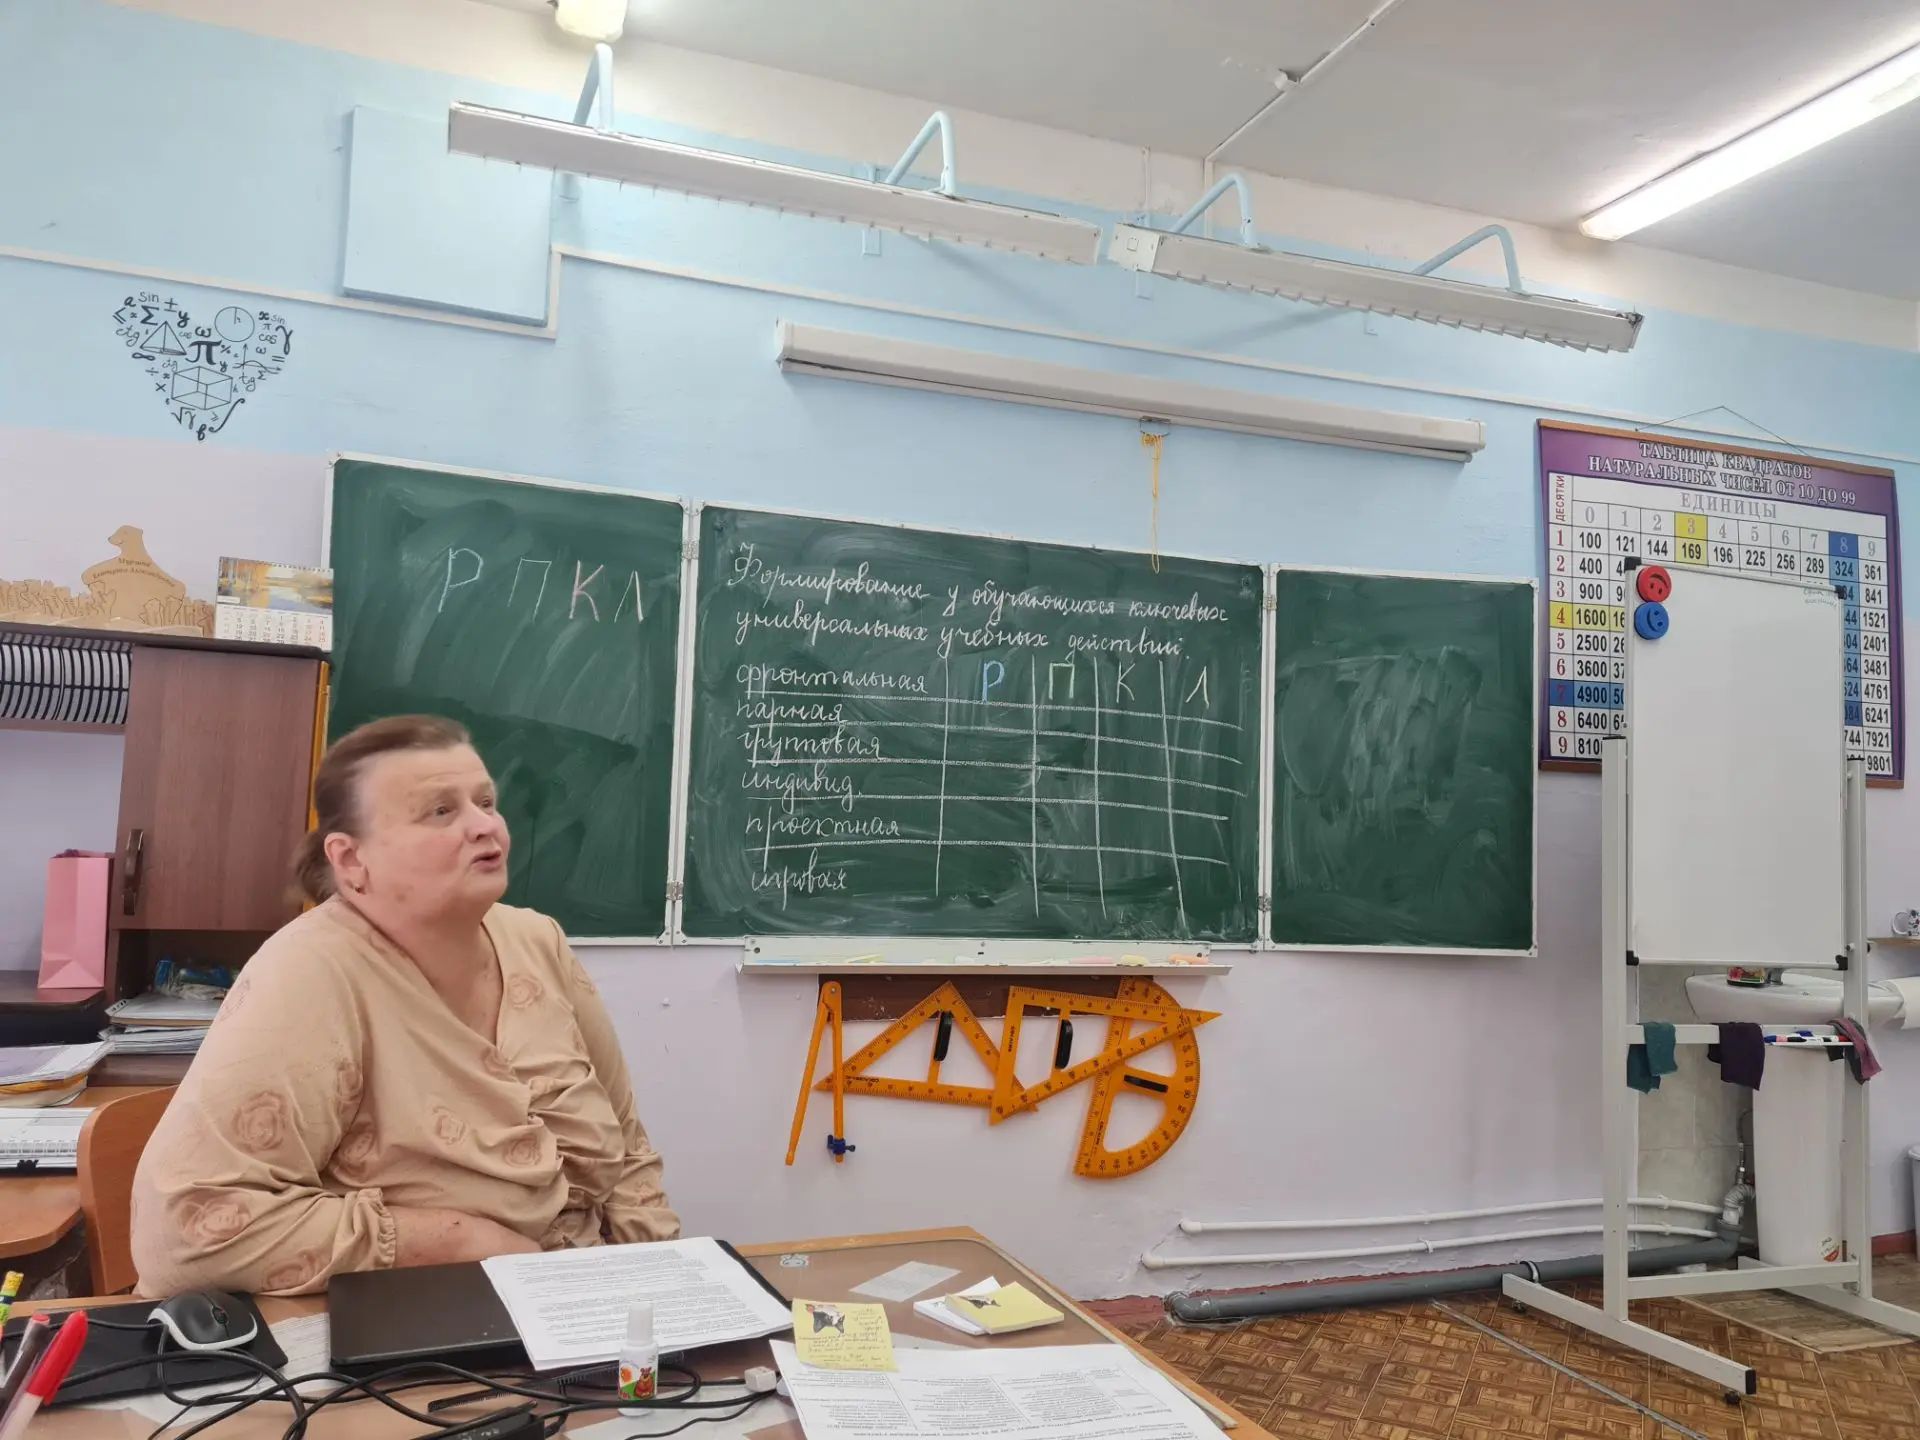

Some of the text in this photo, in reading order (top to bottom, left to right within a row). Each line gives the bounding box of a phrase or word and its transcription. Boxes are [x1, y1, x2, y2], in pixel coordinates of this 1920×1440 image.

[1588, 455, 1857, 506] НАТУРАЛЬНЫХ ЧИСЕЛ ОТ 10 ДО 99
[1638, 441, 1813, 479] ТАБЛИЦА КВАДРАТОВ
[1555, 475, 1565, 522] ДЕСЯТКИ
[1680, 492, 1777, 519] ЕДИНИЦЫ
[1556, 529, 1882, 581] 1 100 121 144 169 196 225 256 289 324 361
[1585, 506, 1876, 557] 0 1 2 3 4 5 6 7 8 9
[438, 547, 644, 625] Р П К Л
[727, 542, 1229, 624] Формирование у обучающихся ключевых
[1556, 555, 1565, 572] 2
[1579, 557, 1602, 574] 400
[1865, 588, 1882, 604] 841
[1556, 580, 1565, 597] 3
[1579, 583, 1602, 600] 900
[1863, 611, 1886, 628] 1521
[735, 598, 929, 645] универсальных
[937, 618, 1050, 659] учебных
[1556, 606, 1565, 624] 4
[1576, 608, 1606, 626] 1600
[1863, 635, 1887, 652] 2401
[1557, 632, 1565, 650] 5
[1576, 633, 1607, 652] 2500
[1863, 659, 1887, 676] 3481
[736, 660, 1211, 709] фронтальная Р П К Л
[1557, 658, 1565, 676] 6
[1577, 660, 1607, 678] 3600
[1864, 683, 1888, 699] 4761
[736, 698, 850, 739] парная
[1557, 684, 1565, 702] 7
[1577, 686, 1607, 703] 4900
[1865, 707, 1889, 723] 6241
[737, 724, 887, 768] групповая
[1557, 710, 1567, 728] 8
[1577, 712, 1607, 730] 6400
[1866, 731, 1889, 747] 7921
[1558, 736, 1891, 772] 9 810 9801
[745, 806, 901, 873] проектная
[751, 847, 848, 912] игровая
